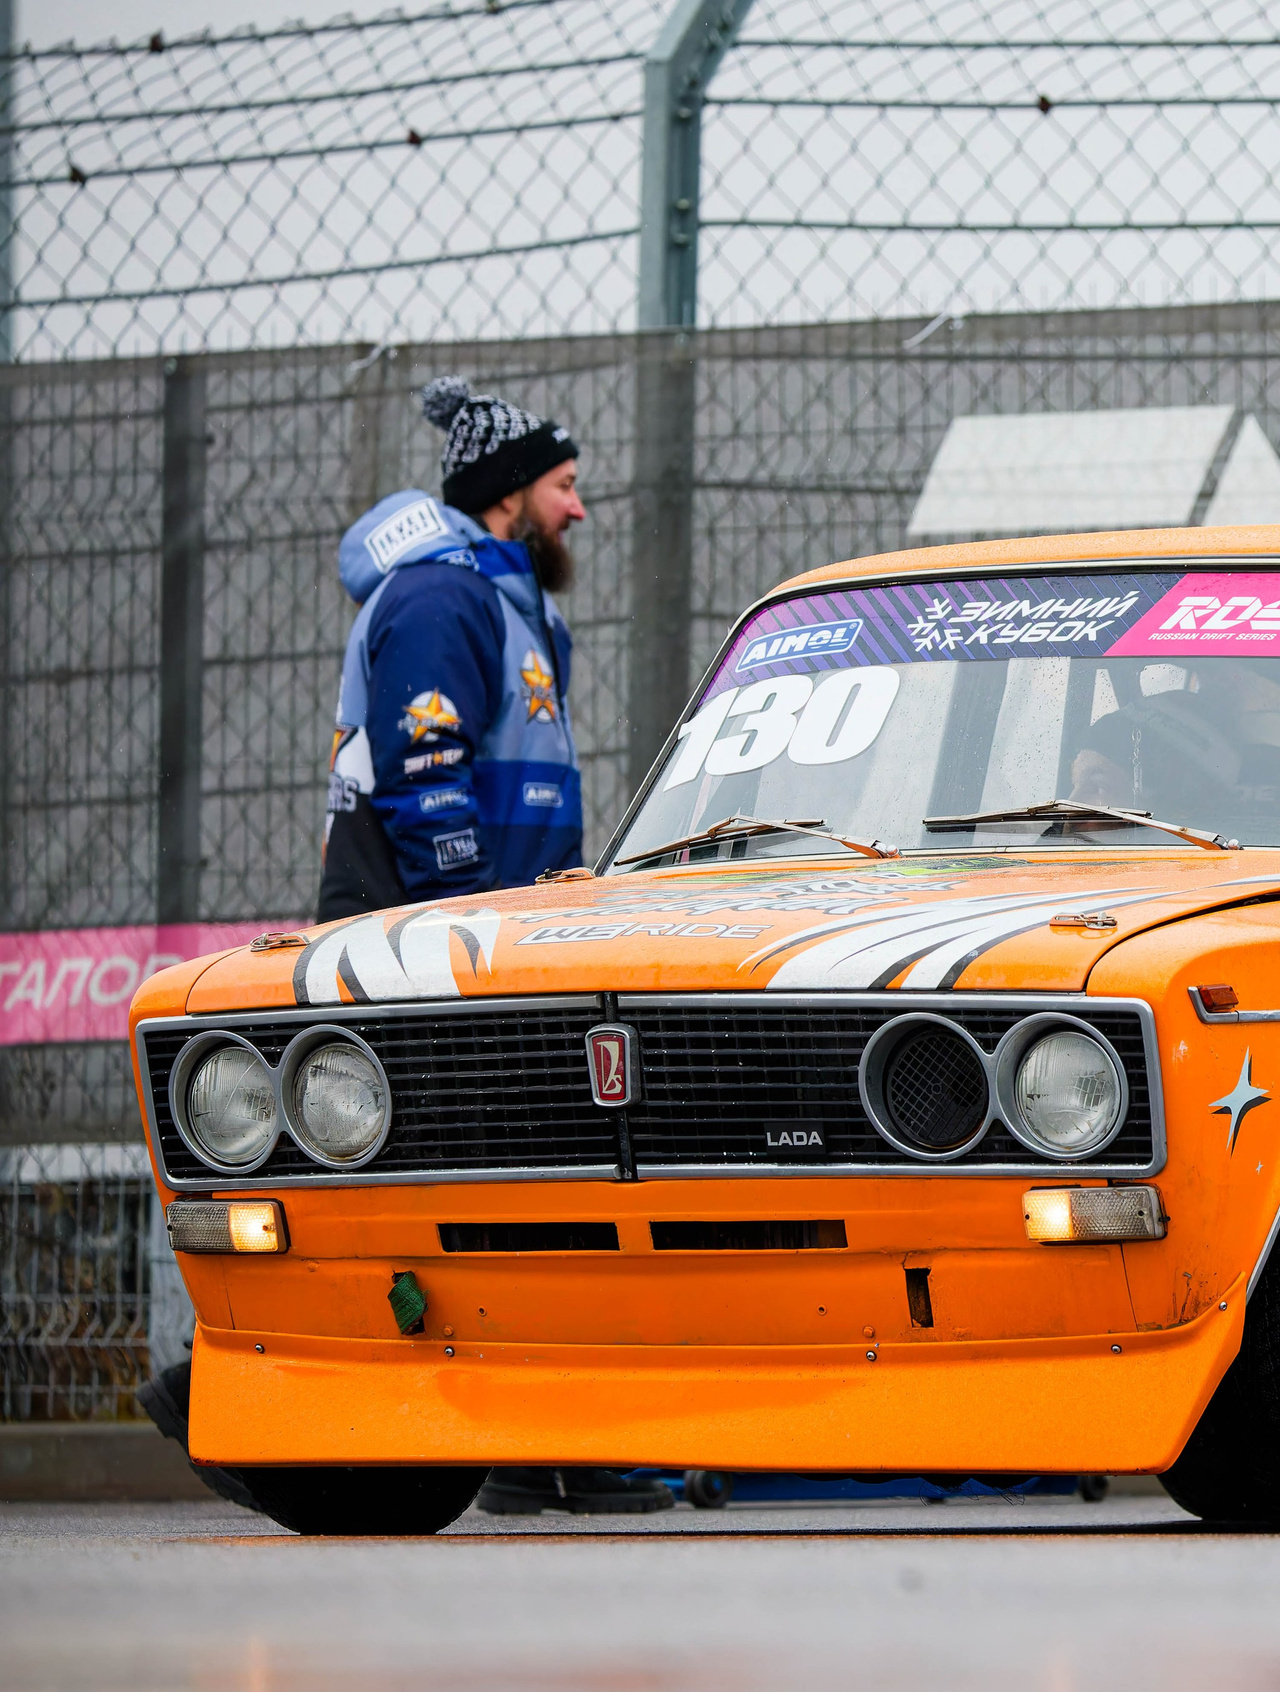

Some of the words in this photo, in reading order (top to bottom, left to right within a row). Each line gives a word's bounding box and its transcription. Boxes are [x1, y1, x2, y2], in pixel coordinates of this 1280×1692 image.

[947, 590, 1140, 623] ЗИМНИЙ
[741, 626, 850, 666] AIMOL
[964, 619, 1117, 645] КУБОК
[1148, 631, 1199, 641] RUSSIAN
[1201, 632, 1234, 641] DRIFT
[1235, 632, 1278, 641] SERIES
[662, 665, 900, 792] 130
[766, 1131, 823, 1147] LADA
